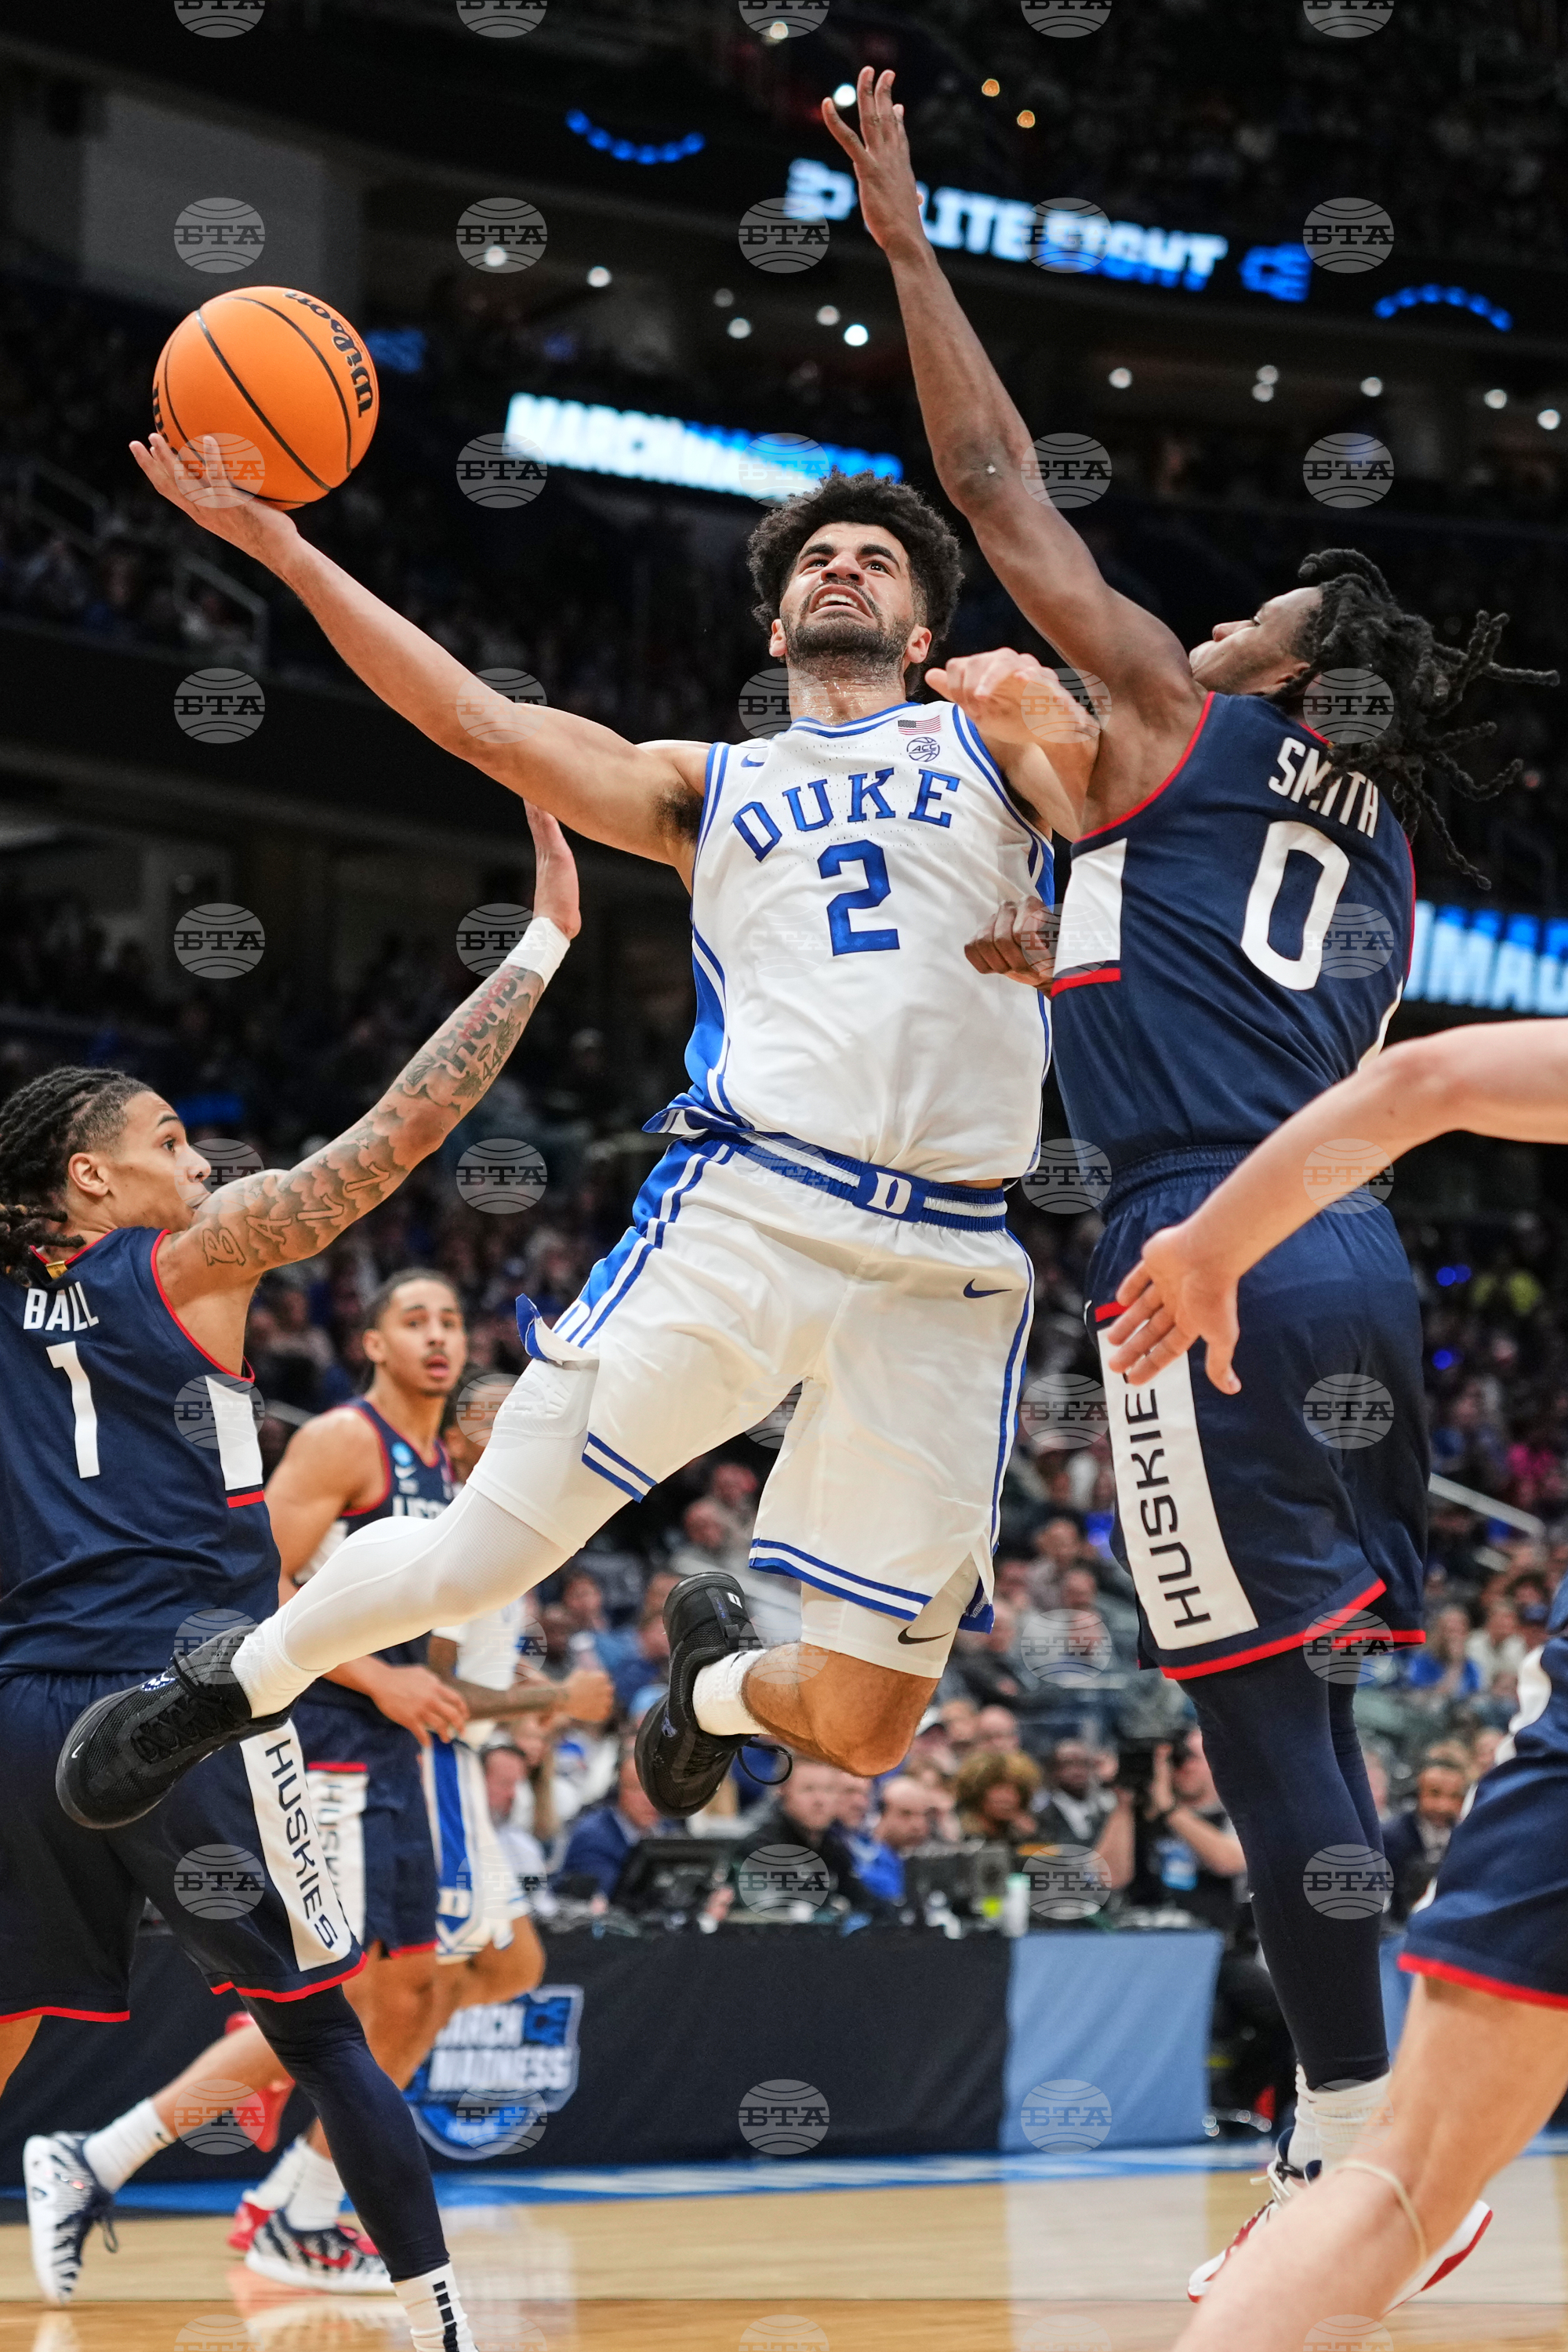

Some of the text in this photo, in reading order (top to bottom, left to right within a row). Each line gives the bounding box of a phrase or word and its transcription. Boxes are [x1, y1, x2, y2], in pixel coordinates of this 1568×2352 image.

[732, 767, 961, 862] DUKE
[1268, 737, 1379, 839] SMITH
[817, 839, 901, 957] 2
[1240, 820, 1350, 991] 0
[866, 1171, 913, 1214] D
[24, 1281, 100, 1332] BALL
[45, 1341, 100, 1479] 1
[1124, 1372, 1212, 1630] HUSKIE
[265, 1738, 339, 1950] HUSKIES
